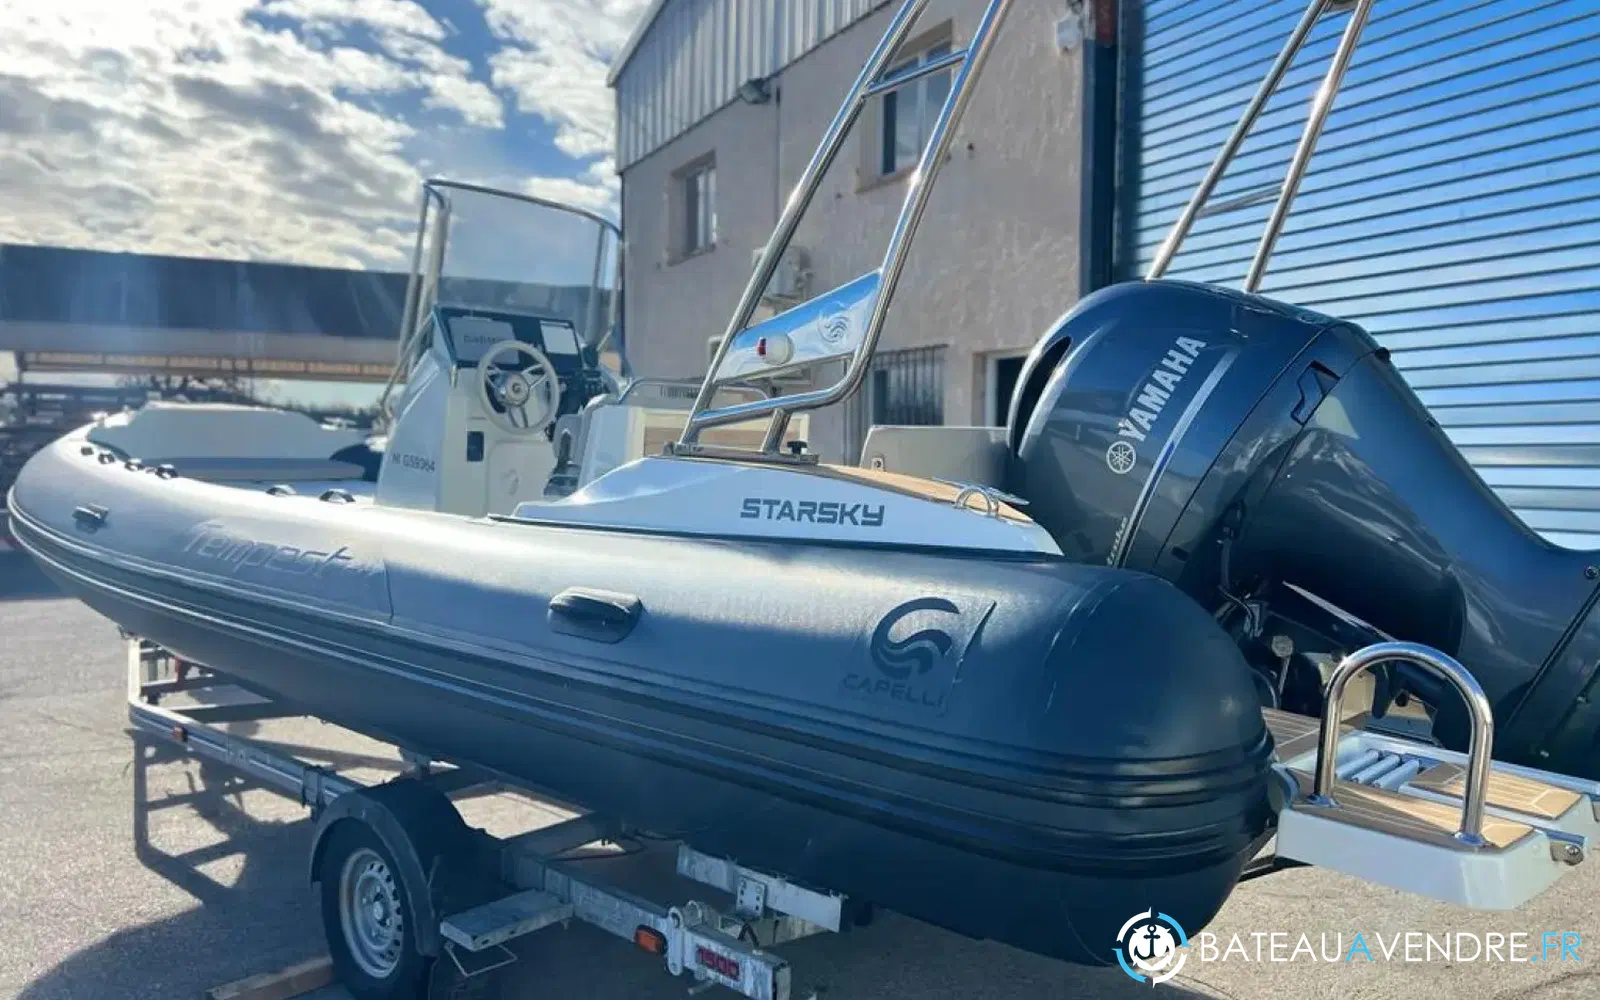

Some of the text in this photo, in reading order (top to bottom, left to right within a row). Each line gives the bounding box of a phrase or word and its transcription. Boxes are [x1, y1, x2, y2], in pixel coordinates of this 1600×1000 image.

[1118, 335, 1208, 442] YAMAHA
[740, 497, 885, 527] STARSKY
[843, 673, 945, 708] CAPELLI
